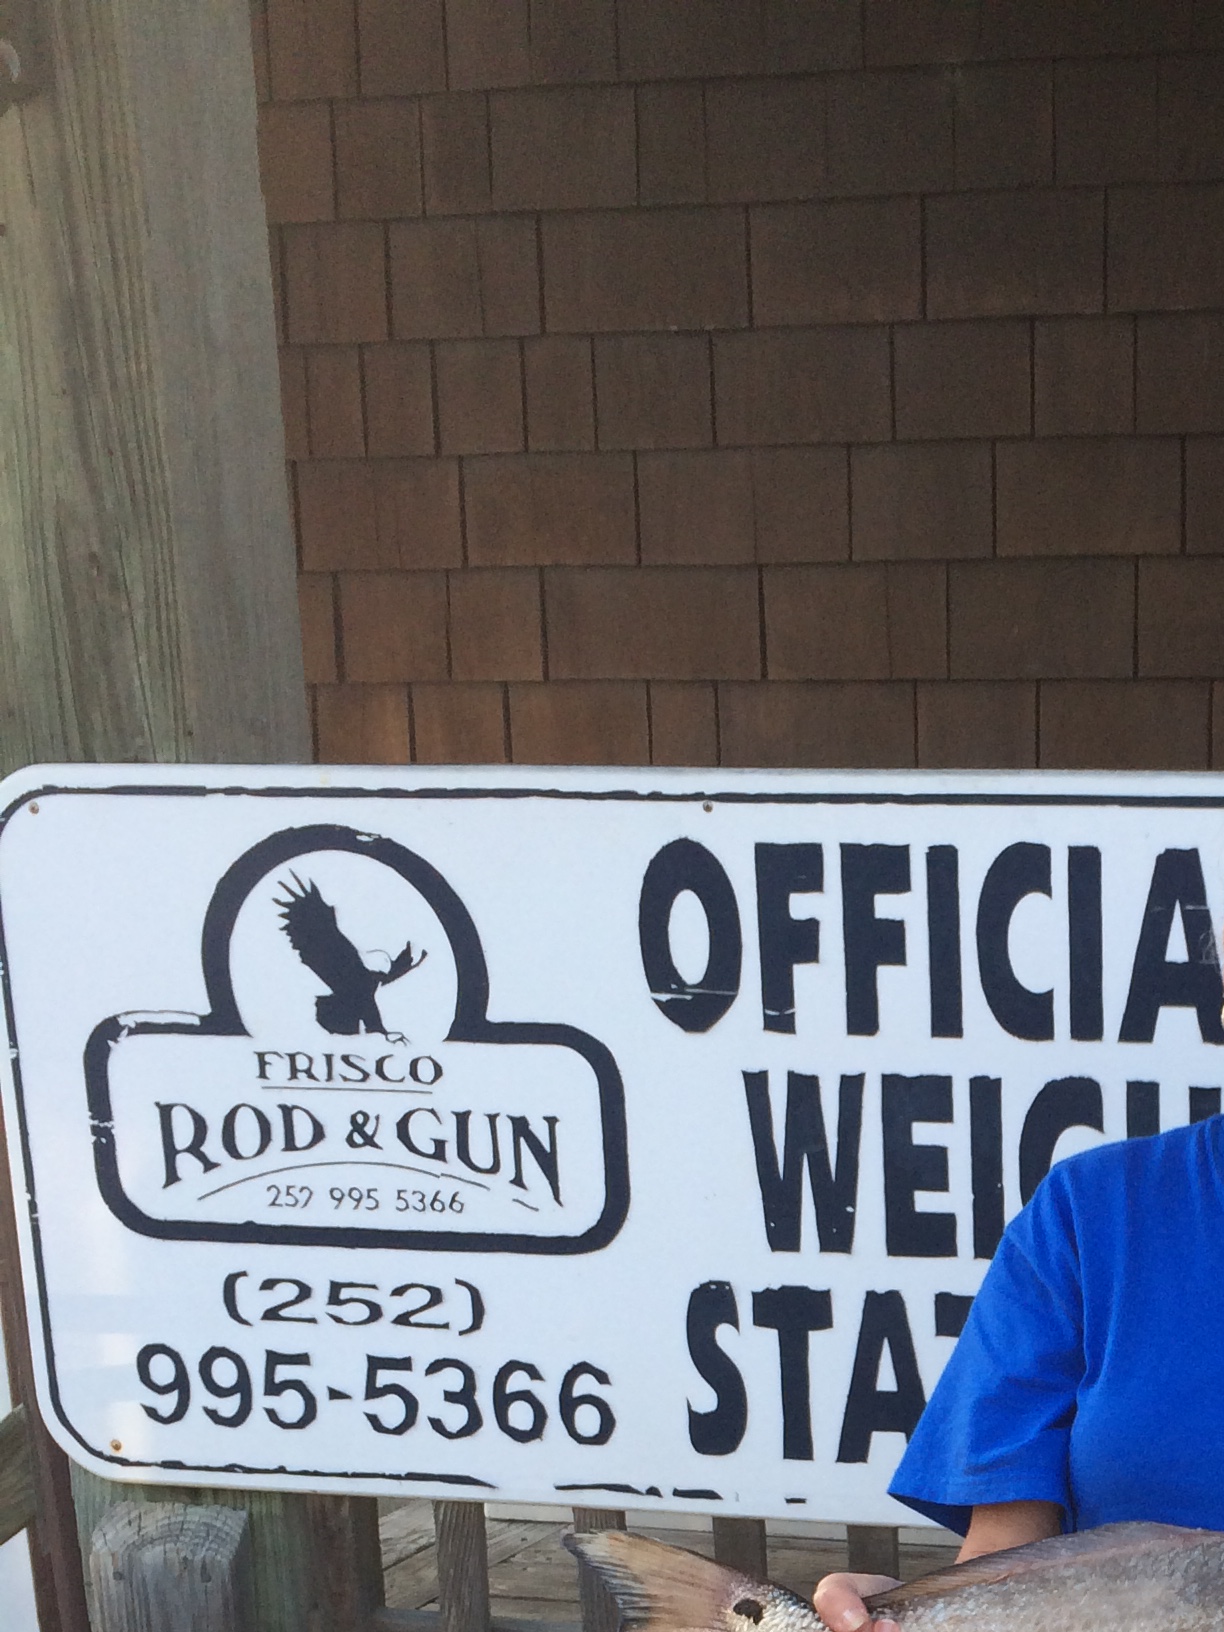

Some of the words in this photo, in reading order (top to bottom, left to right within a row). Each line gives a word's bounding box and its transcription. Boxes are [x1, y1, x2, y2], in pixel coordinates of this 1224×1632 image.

[254, 1051, 444, 1086] FRISCO
[154, 1102, 326, 1190] ROD
[345, 1110, 384, 1150] &
[396, 1107, 564, 1208] GUN
[329, 1187, 380, 1212] 995
[396, 1189, 465, 1214] 5366
[222, 1270, 486, 1337] (252)
[136, 1343, 617, 1447] 995-5366
